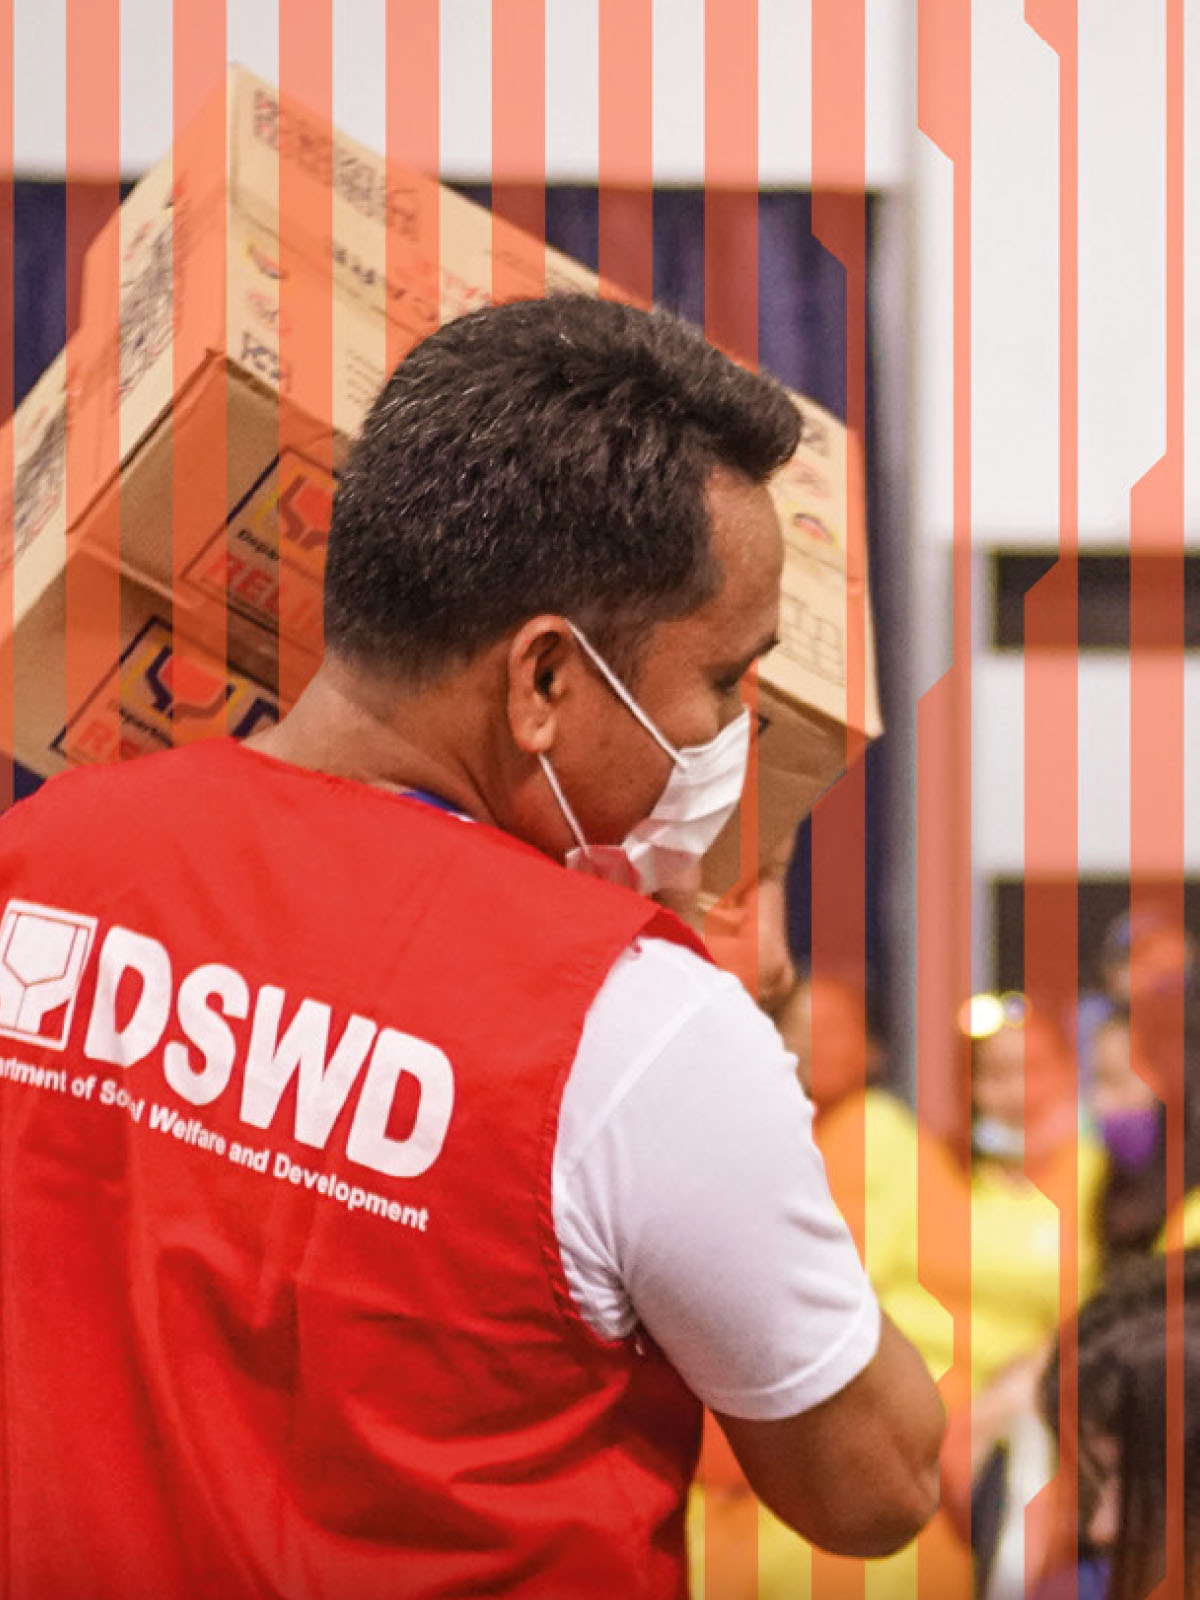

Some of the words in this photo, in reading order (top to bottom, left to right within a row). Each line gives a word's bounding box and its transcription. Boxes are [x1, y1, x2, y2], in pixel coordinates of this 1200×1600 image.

[71, 1075, 97, 1100] of
[149, 1103, 227, 1156] Welfare
[228, 1142, 270, 1174] and
[272, 1152, 429, 1232] Development
[84, 925, 455, 1178] DSWD
